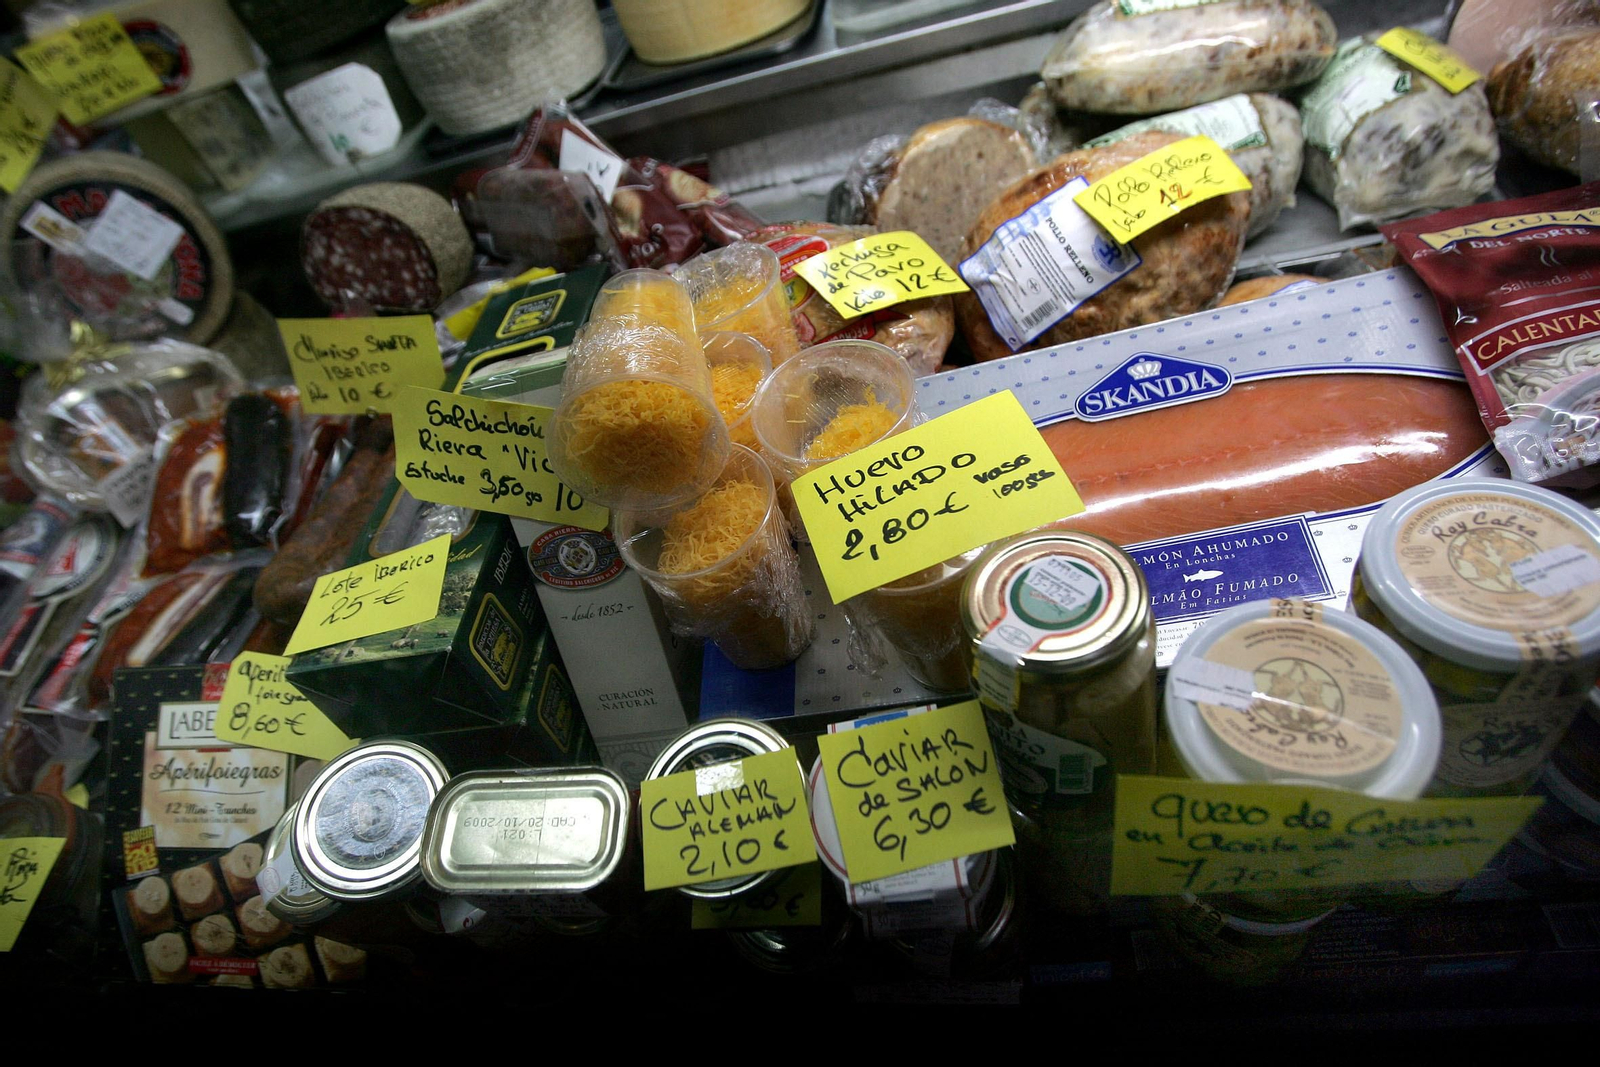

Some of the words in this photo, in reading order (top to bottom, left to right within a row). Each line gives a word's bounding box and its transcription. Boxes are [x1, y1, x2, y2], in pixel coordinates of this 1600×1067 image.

[1160, 183, 1192, 207] 12
[1440, 224, 1477, 240] LA
[1491, 211, 1589, 233] GULA
[1469, 239, 1511, 250] DEL
[1517, 226, 1590, 245] NORTE
[1045, 217, 1067, 245] POLLO
[1063, 244, 1095, 285] RELLENO
[1500, 274, 1572, 295] Salteada
[339, 386, 360, 403] 10
[1085, 368, 1223, 414] SKANDIA
[418, 429, 487, 460] Riera
[1438, 504, 1474, 518] CURADO
[536, 533, 555, 547] CASA
[554, 526, 576, 537] RIERA
[1133, 548, 1184, 566] LMÓN
[1193, 531, 1289, 557] AHUMADO
[493, 540, 514, 585] IBERIC
[1165, 562, 1180, 570] En
[1187, 553, 1236, 566] Lonchas
[320, 571, 363, 598] Lote
[1151, 588, 1201, 606] LMÃO
[1215, 573, 1299, 595] FUMADO
[571, 603, 595, 622] desde
[597, 603, 624, 618] 1852
[1180, 601, 1197, 610] Em
[1206, 594, 1248, 606] Fatias
[599, 687, 654, 703] CURACIÓN
[602, 697, 658, 711] NATURAL
[170, 709, 216, 740] LABE
[149, 755, 283, 788] Apérifoiegras
[165, 803, 182, 815] 12
[650, 779, 777, 830] CAVIAR
[859, 791, 890, 817] de
[690, 797, 796, 841] ALEMAN
[873, 802, 951, 862] 6,30
[963, 787, 996, 815] €
[680, 839, 760, 876] 2,10
